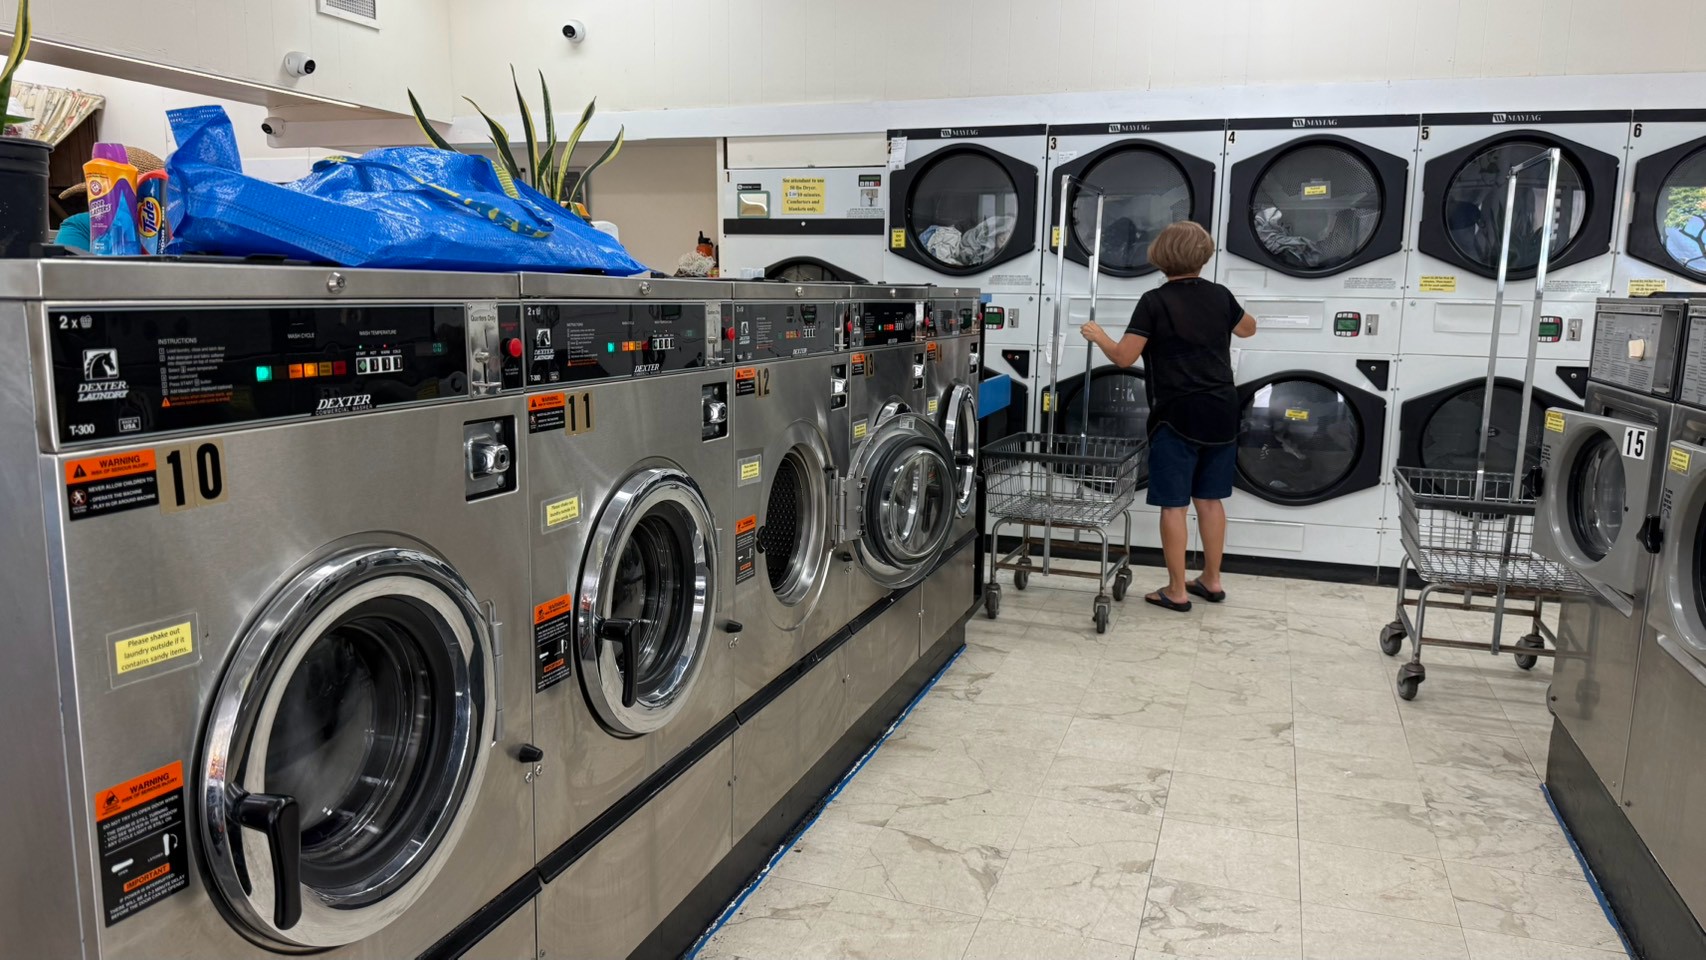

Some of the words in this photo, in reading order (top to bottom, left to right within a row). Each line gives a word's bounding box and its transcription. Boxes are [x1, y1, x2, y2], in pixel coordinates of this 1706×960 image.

[1228, 131, 1236, 144] 4
[1422, 127, 1429, 140] 5
[1634, 123, 1643, 138] 6
[1050, 137, 1057, 150] 3
[142, 200, 157, 233] Tide
[59, 315, 69, 330] 2
[158, 337, 197, 345] INSTRUCTIONS
[634, 364, 660, 373] DEXTER
[78, 381, 127, 393] DEXTER
[757, 368, 770, 397] 12
[78, 390, 130, 402] LAUNDRY
[317, 394, 371, 410] DEXTER
[315, 407, 350, 416] COMMERCIAL
[352, 404, 373, 412] WASHER
[568, 393, 590, 431] 11
[70, 424, 96, 436] T-300
[1626, 430, 1645, 457] 15
[99, 455, 141, 468] WARNING
[166, 442, 223, 506] 10
[88, 485, 105, 493] NEVER
[106, 482, 122, 490] ALLOW
[123, 479, 146, 488] CHILDREN
[123, 489, 142, 497] MACHINE
[137, 494, 156, 502] MACHINE
[128, 637, 150, 648] Please
[150, 632, 168, 642] shake
[169, 628, 180, 637] out
[124, 648, 149, 659] laundry
[150, 640, 174, 652] outside
[121, 658, 150, 671] contains
[151, 652, 168, 663] sandy
[170, 647, 188, 657] items.
[130, 773, 170, 794] WARNING
[126, 866, 167, 889] IMPORTANT
